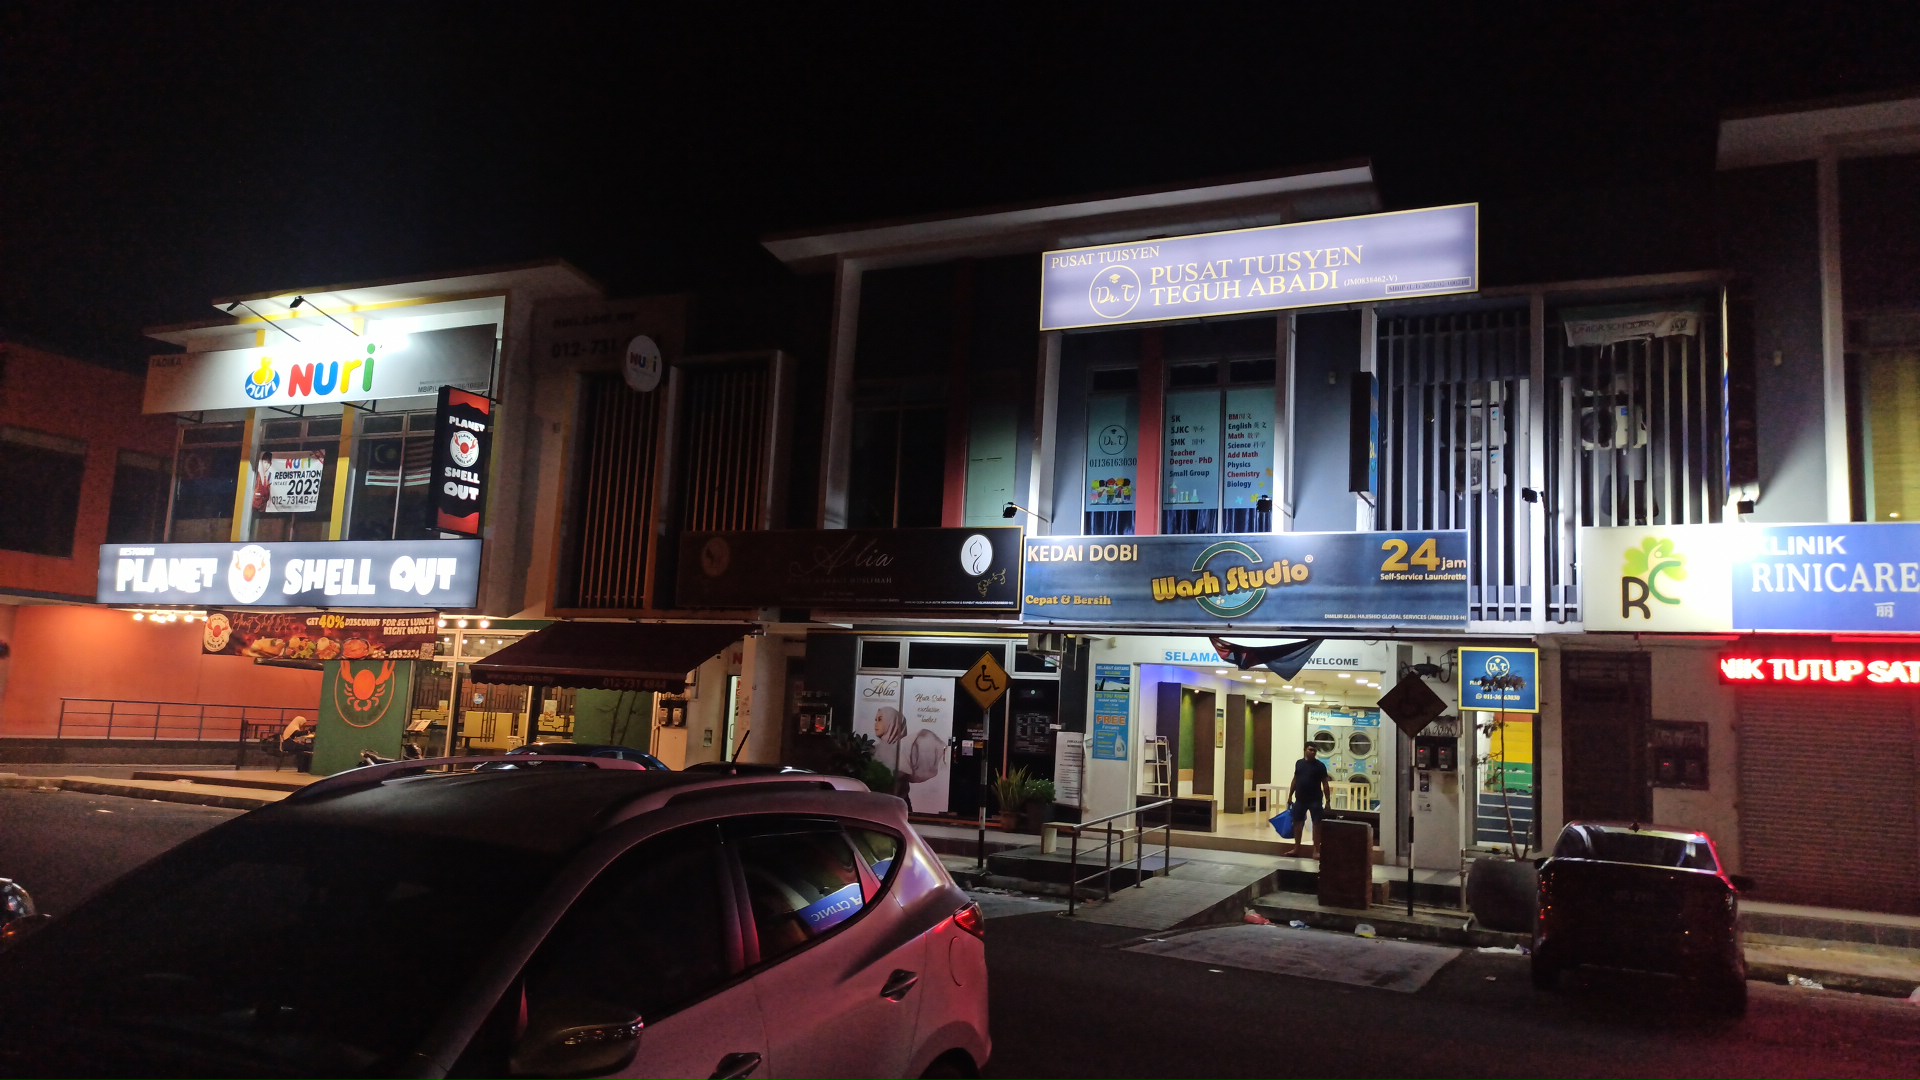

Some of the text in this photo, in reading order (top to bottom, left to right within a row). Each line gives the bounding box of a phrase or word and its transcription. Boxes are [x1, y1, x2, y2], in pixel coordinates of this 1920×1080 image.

[1051, 246, 1160, 268] PUSAT TUISYEN
[1150, 245, 1363, 285] PUSAT TUISYEN
[1150, 270, 1339, 306] TEGUH ABADI
[449, 415, 485, 432] PLANET
[1171, 426, 1189, 434] SJKC
[1228, 422, 1252, 431] English
[1171, 438, 1185, 446] SMK
[1170, 449, 1196, 457] Teacher
[1089, 458, 1137, 468] 01136163030
[1170, 458, 1193, 466] Degree
[274, 470, 321, 480] REGISTRATION
[444, 466, 480, 484] SHELL
[1190, 470, 1210, 478] Group
[286, 479, 320, 495] 2023
[444, 481, 479, 501] OUT
[1028, 544, 1138, 562] KEDAI DOBI
[1381, 538, 1466, 571] 24 jam
[116, 556, 457, 595] PLANET SHELL OUT
[1152, 559, 1309, 601] Wash Studio
[1380, 573, 1466, 581] Self-Service Laundrette
[1751, 562, 1920, 593] RINICARE
[1025, 595, 1058, 606] Cepat
[1061, 595, 1071, 604] &
[1073, 595, 1112, 605] Bersih
[307, 615, 434, 628] GET 40% DISCOUNT FOR SET LUNCH
[383, 626, 406, 635] RIGHT
[407, 626, 427, 635] NOW
[1164, 651, 1224, 663] SELAMA
[1307, 657, 1359, 666] WELCOME
[1766, 659, 1864, 681] TUTUP
[863, 678, 898, 698] Alia
[1096, 714, 1126, 726] FREE
